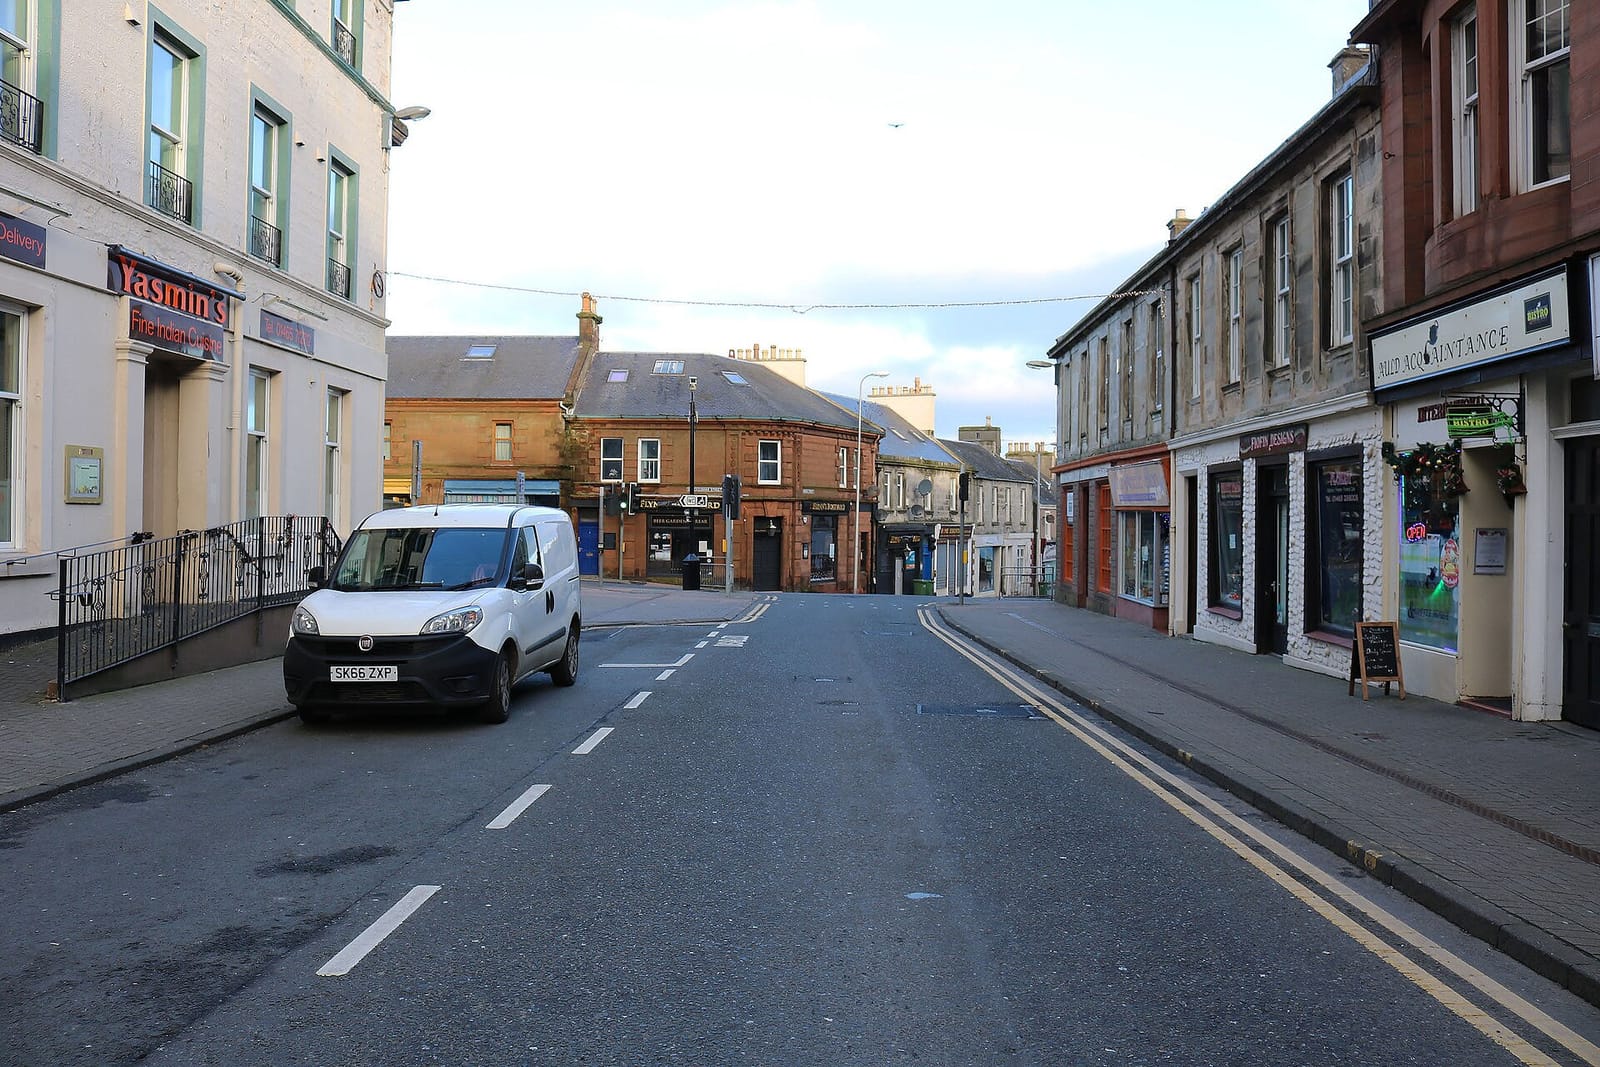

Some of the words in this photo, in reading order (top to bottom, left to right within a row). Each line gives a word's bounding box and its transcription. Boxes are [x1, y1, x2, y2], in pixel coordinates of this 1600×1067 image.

[0, 222, 44, 257] Delivery
[116, 255, 227, 324] Yasmin's
[1527, 307, 1549, 321] BISTRO
[131, 309, 155, 335] Fine
[157, 316, 186, 345] Indian
[188, 326, 223, 356] Cuisine
[1377, 357, 1400, 379] AULD
[1453, 418, 1489, 427] BISTRO
[1406, 526, 1426, 539] OPEN
[335, 667, 366, 679] SK66
[368, 667, 392, 679] ZXP
